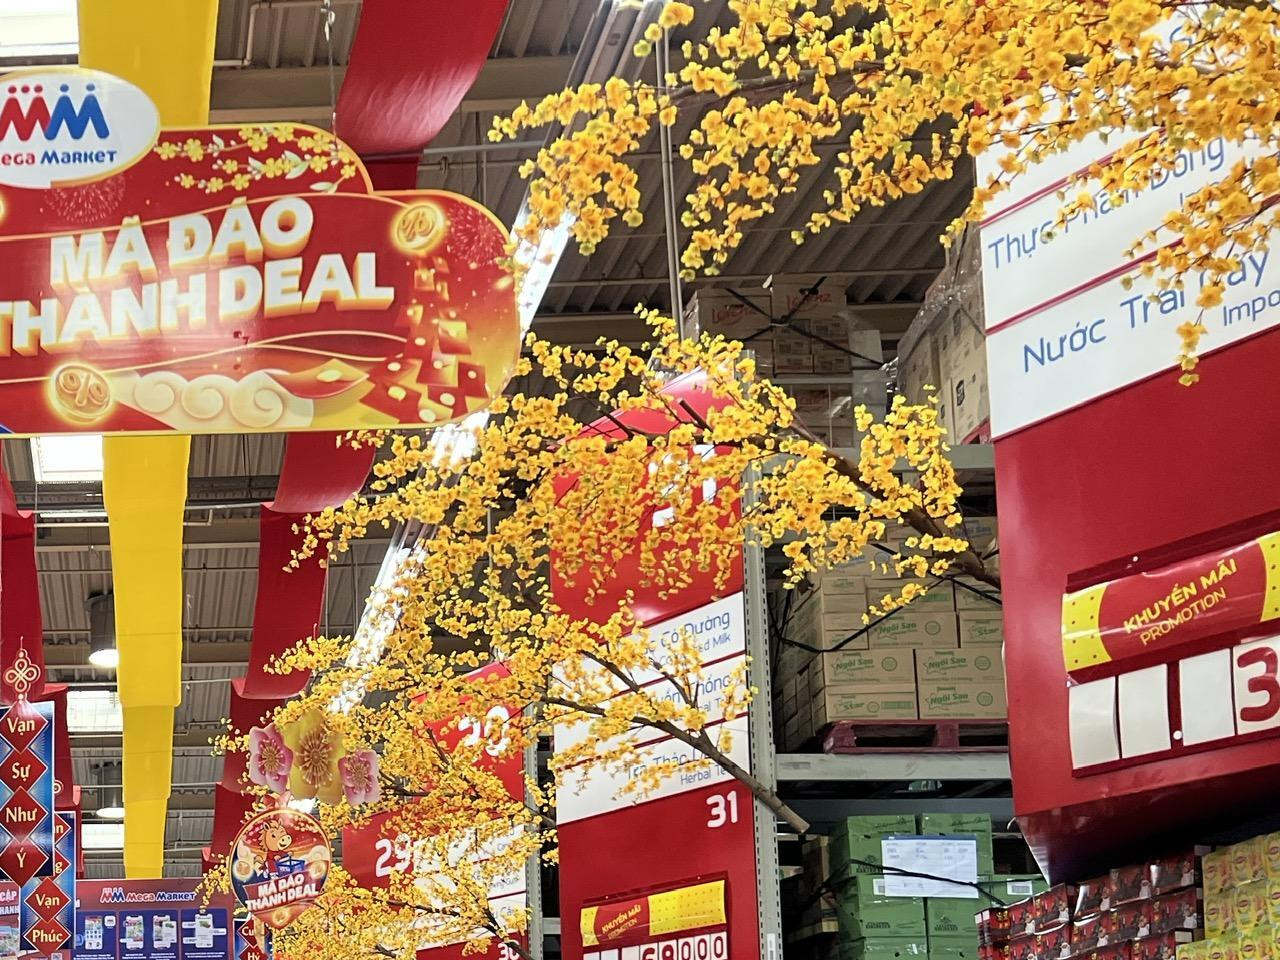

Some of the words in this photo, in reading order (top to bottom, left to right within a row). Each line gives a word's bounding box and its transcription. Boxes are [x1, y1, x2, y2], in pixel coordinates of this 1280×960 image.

[50, 214, 156, 290] MÃ
[167, 196, 314, 270] ĐÁO
[219, 252, 394, 322] DEAL
[1024, 319, 1107, 373] Nước
[1123, 580, 1197, 634] KHUYẾN
[1200, 558, 1238, 590] MÃI
[1139, 587, 1227, 645] PROMOTION
[713, 634, 730, 648] Milk
[6, 717, 35, 736] Vạn
[11, 762, 30, 781] Sự
[680, 766, 711, 785] Herbal
[6, 807, 37, 822] Như
[706, 790, 738, 828] 31
[16, 848, 26, 868] Ý
[35, 894, 60, 910] Vạn
[287, 884, 319, 903] DEAL
[32, 928, 62, 944] Phúc
